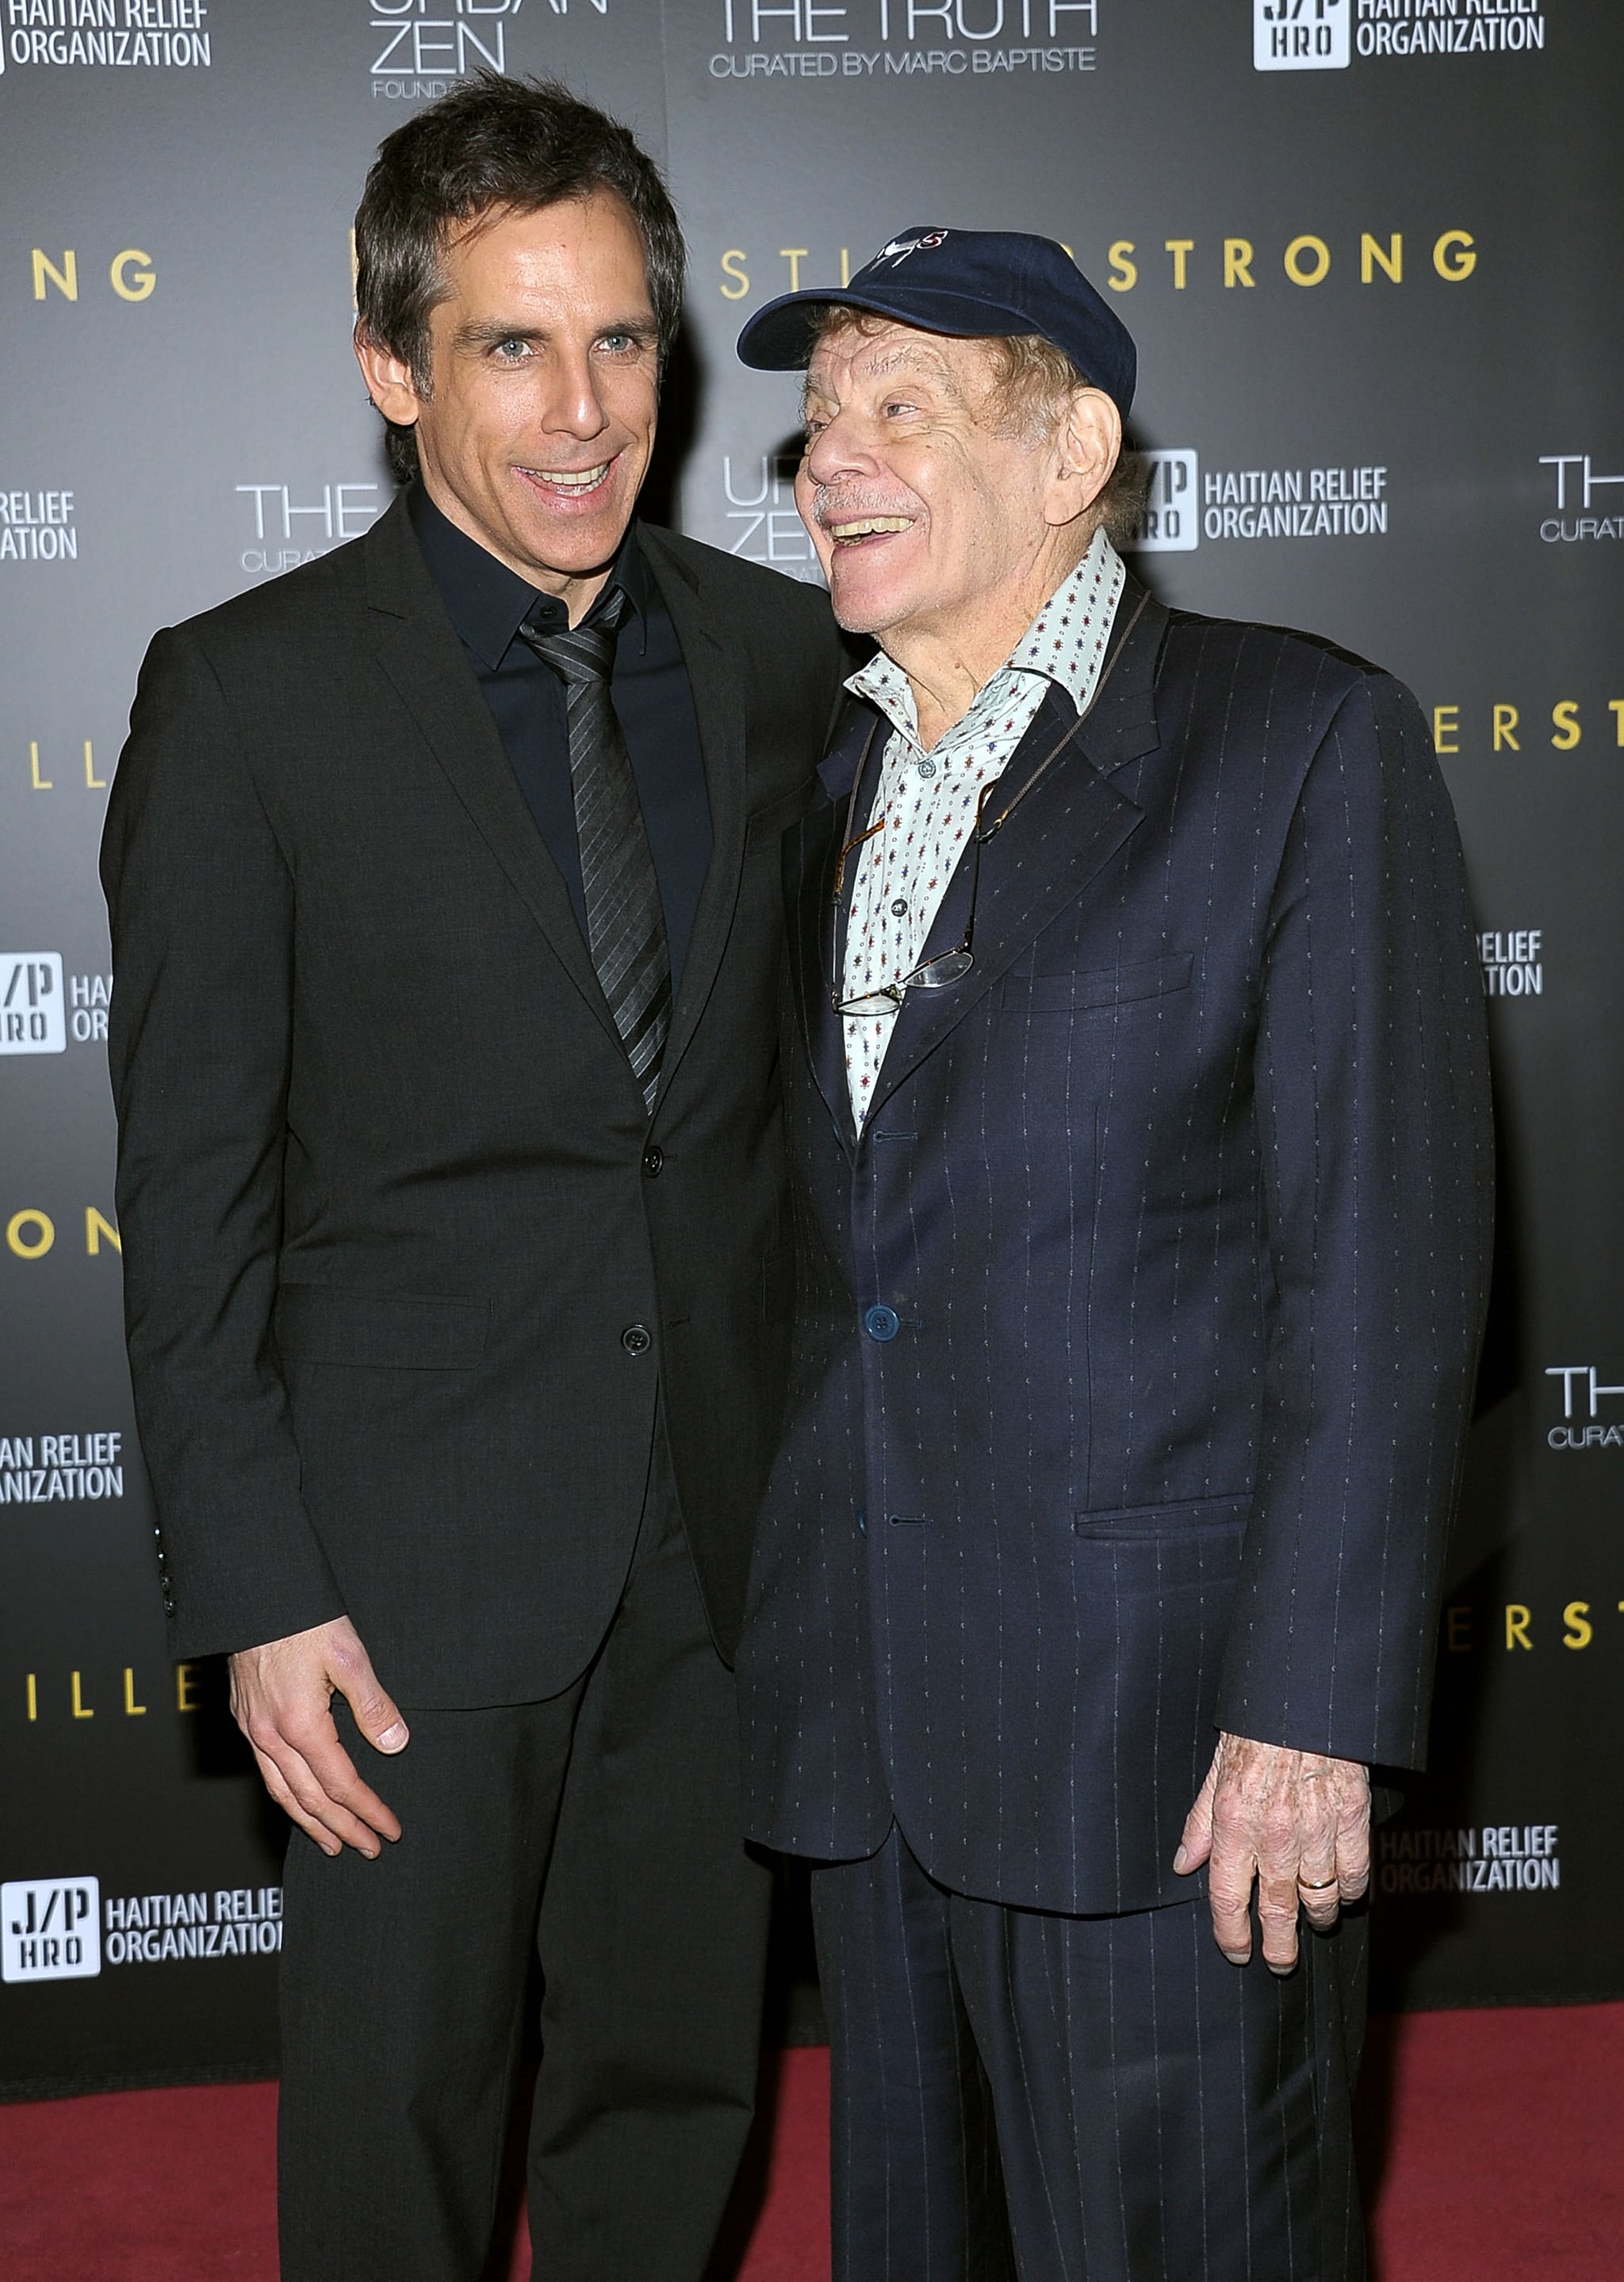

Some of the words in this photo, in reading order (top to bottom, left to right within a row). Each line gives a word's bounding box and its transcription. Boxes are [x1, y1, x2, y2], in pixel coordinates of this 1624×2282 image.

[9, 0, 116, 28] HAITIAN
[126, 0, 208, 29] RELIEF
[724, 0, 849, 43] THE
[882, 0, 1098, 41] TRUTH
[10, 29, 211, 67] ORGANIZATION
[370, 20, 505, 75] ZEN
[1271, 25, 1332, 57] HRO
[1357, 16, 1545, 56] ORGANIZATION
[709, 52, 837, 78] CURATED
[843, 52, 880, 75] BY
[884, 49, 967, 75] MARC
[971, 48, 1097, 74] BAPTISTE
[33, 248, 157, 301] NG
[1205, 469, 1303, 505] HAITIAN
[1310, 466, 1388, 501] RELIEF
[235, 484, 378, 539] THE
[1205, 501, 1388, 539] ORGANIZATION
[0, 526, 78, 560] ATION
[726, 511, 817, 561] ZE
[1476, 930, 1542, 963] ELIEF
[1482, 963, 1543, 996] TION
[40, 1432, 121, 1468] RELIEF
[1547, 1426, 1624, 1451] CURA
[1381, 1828, 1477, 1860] HAITIAN
[1482, 1825, 1559, 1859] RELIEF
[1381, 1858, 1561, 1893] ORGANIZATION
[12, 1888, 90, 1935] J/P
[105, 1892, 207, 1931] HAITIAN
[214, 1887, 283, 1924] RELIE
[20, 1936, 82, 1970] HRO
